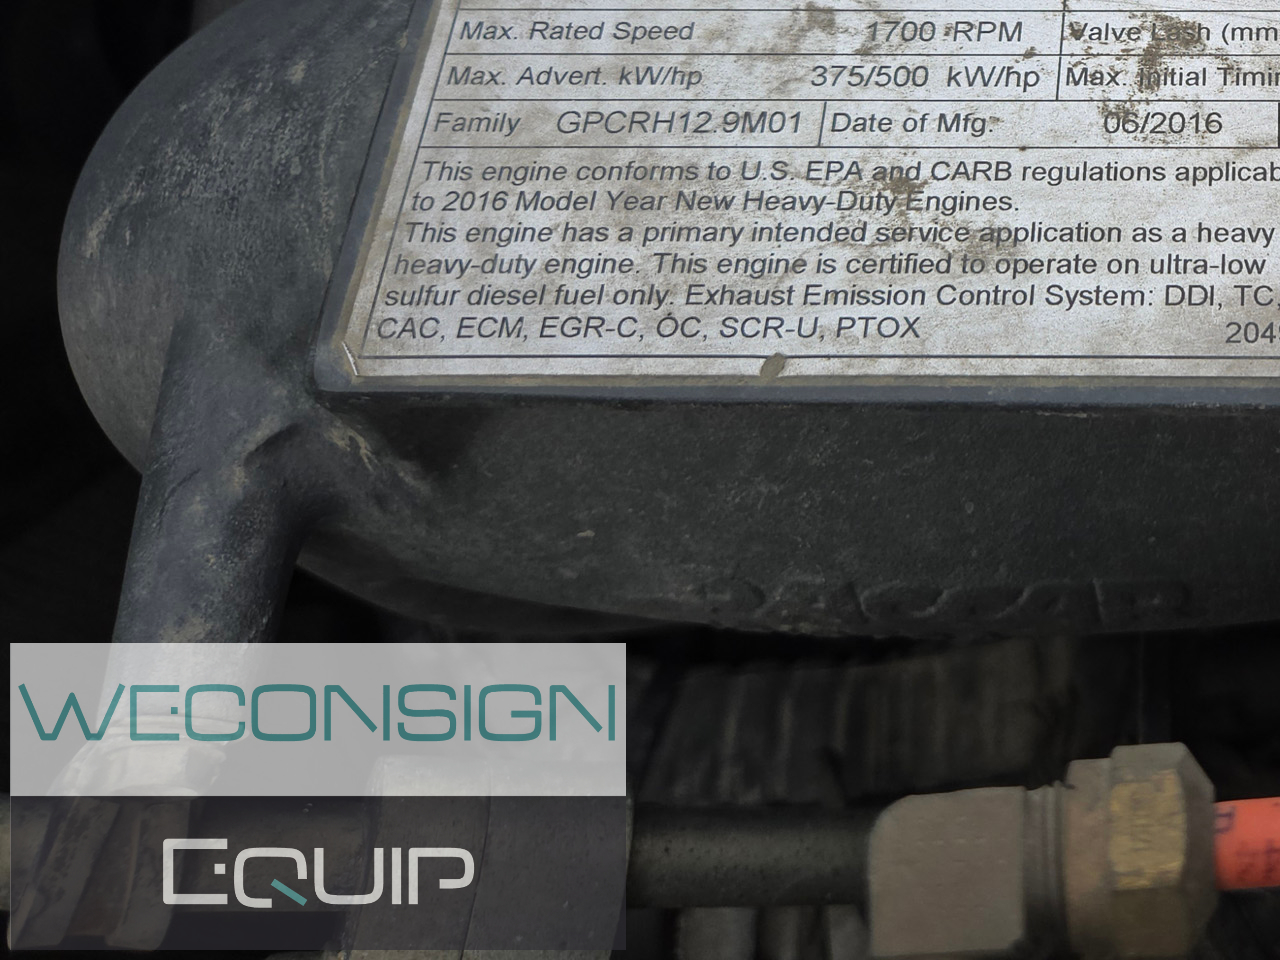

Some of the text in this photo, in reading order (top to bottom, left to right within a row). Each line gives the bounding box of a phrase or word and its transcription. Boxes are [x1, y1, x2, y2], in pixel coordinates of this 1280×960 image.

[460, 20, 1024, 45] Max. Rated Speed 1700 RPM
[1069, 22, 1141, 42] Valve
[447, 65, 1040, 93] Max. Advert. kW/hp 375/500 kW/hp
[1065, 67, 1126, 87] Max.
[1138, 67, 1207, 87] Initial
[434, 111, 802, 137] Family GPCRH12.9M01
[831, 111, 1223, 138] Date of Mfg. 06/2016
[423, 160, 475, 182] This
[482, 161, 568, 186] engine
[576, 160, 699, 182] conforms
[706, 161, 732, 182] to
[740, 160, 795, 182] U.S.
[805, 160, 863, 182] EPA
[871, 160, 922, 182] and
[930, 160, 1013, 182] CARB
[1021, 160, 1167, 187] regulations
[411, 190, 1020, 217] to 2016 Model Year New Heavy-Duty Engines.
[405, 221, 1276, 249] This engine has a primary intended service application as a heavy
[393, 252, 1267, 281] heavy-duty engine. This engine is certified to operate on ultra-low
[384, 283, 458, 307] sulfur
[467, 283, 546, 307] diesel
[553, 283, 604, 307] fuel
[613, 283, 675, 312] only.
[684, 283, 796, 307] Exhaust
[802, 283, 927, 307] Emission
[936, 283, 1036, 307] Control
[1045, 283, 1155, 312] System:
[1164, 284, 1223, 311] DDI,
[376, 315, 921, 342] CAC, ECM, EGR-C, OC, SCR-U, PTOX
